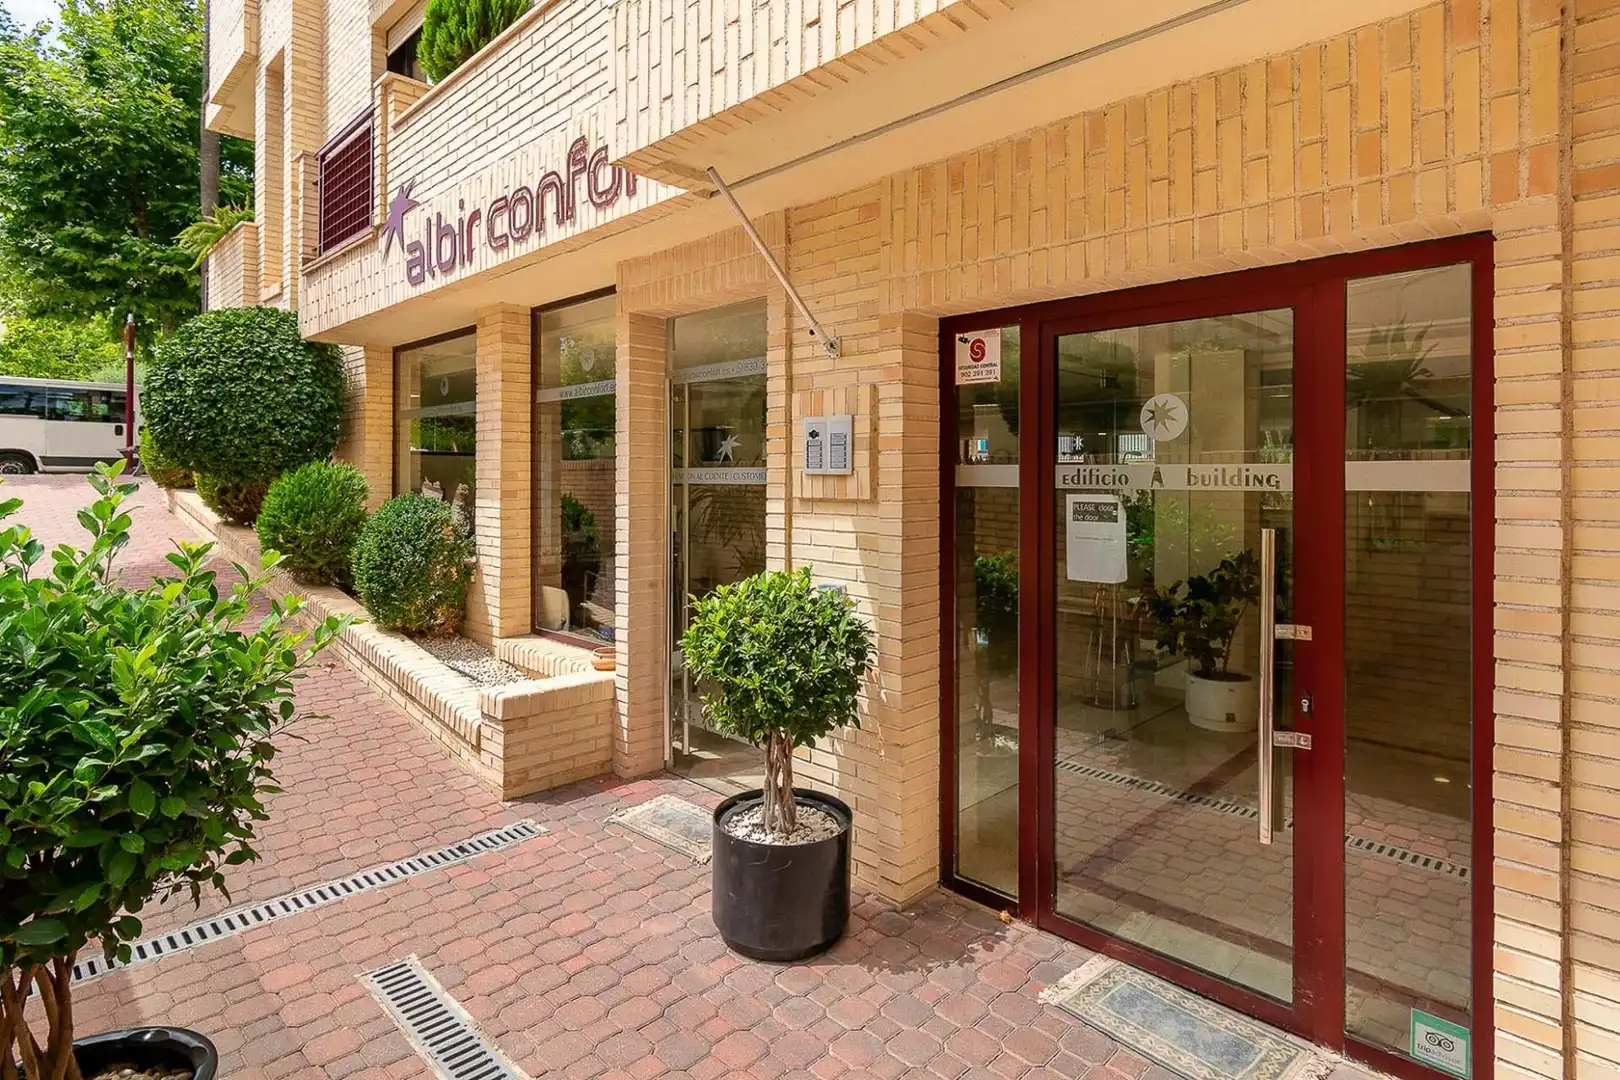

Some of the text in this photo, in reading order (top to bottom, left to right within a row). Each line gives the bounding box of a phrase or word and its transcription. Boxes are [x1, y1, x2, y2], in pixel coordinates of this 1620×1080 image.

[1062, 468, 1129, 487] Edificio
[1151, 466, 1164, 488] A
[1073, 503, 1096, 511] PLEASE
[1084, 513, 1099, 521] door
